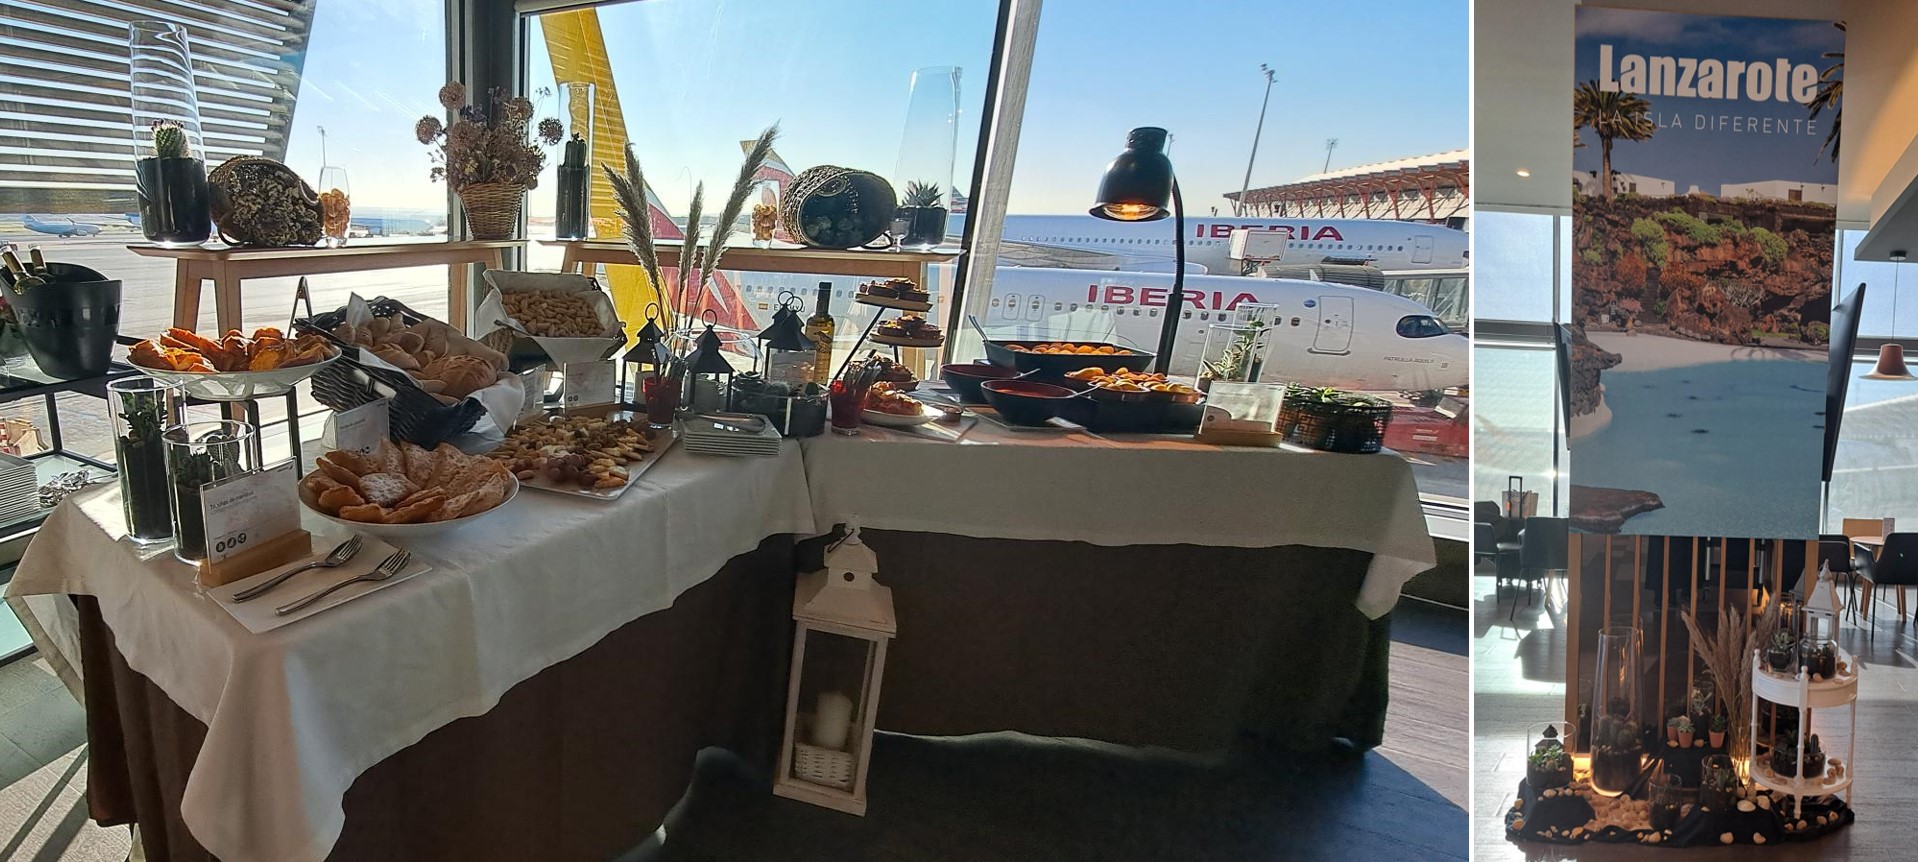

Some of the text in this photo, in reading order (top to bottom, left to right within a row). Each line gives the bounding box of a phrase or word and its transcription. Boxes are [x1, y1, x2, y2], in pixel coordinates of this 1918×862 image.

[1599, 44, 1819, 104] Lanzarote
[1598, 108, 1817, 136] LA ISLA DIFERENTE
[1088, 284, 1260, 311] IBERIA
